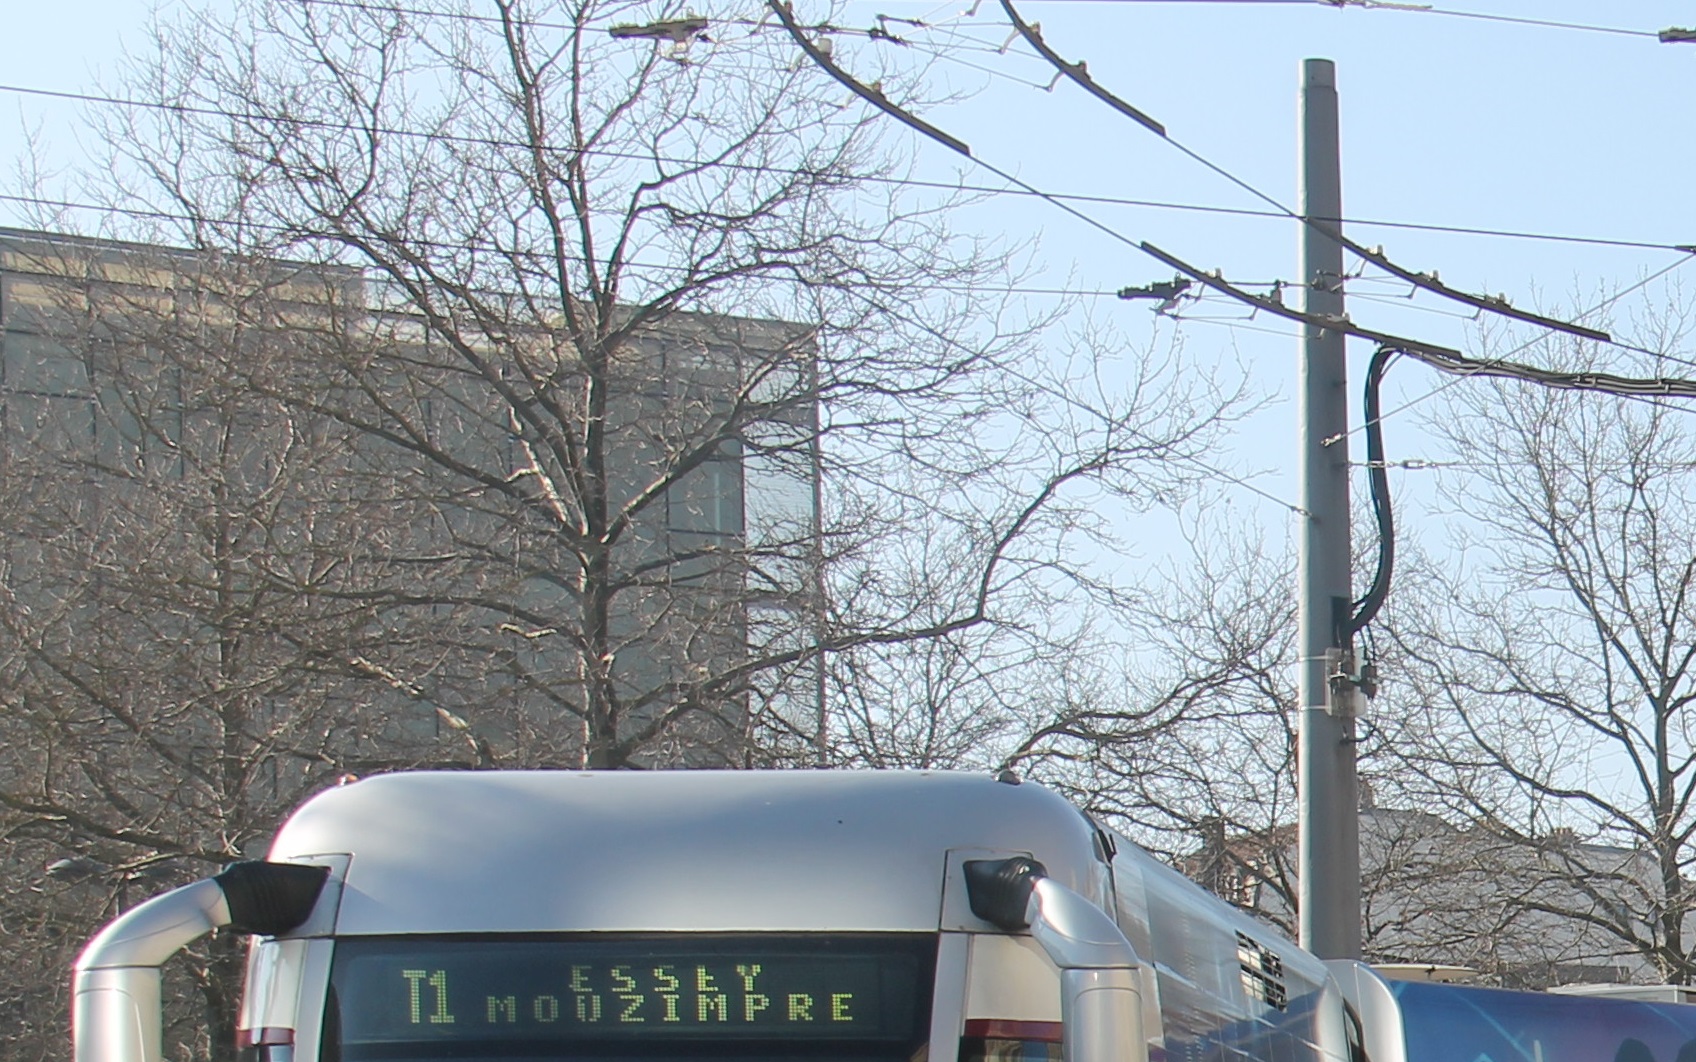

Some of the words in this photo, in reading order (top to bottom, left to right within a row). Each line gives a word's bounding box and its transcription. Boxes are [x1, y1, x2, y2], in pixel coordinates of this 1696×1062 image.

[569, 964, 762, 993] ESSEY
[401, 969, 455, 1024] T1
[486, 993, 855, 1022] MOUZIMPRE
